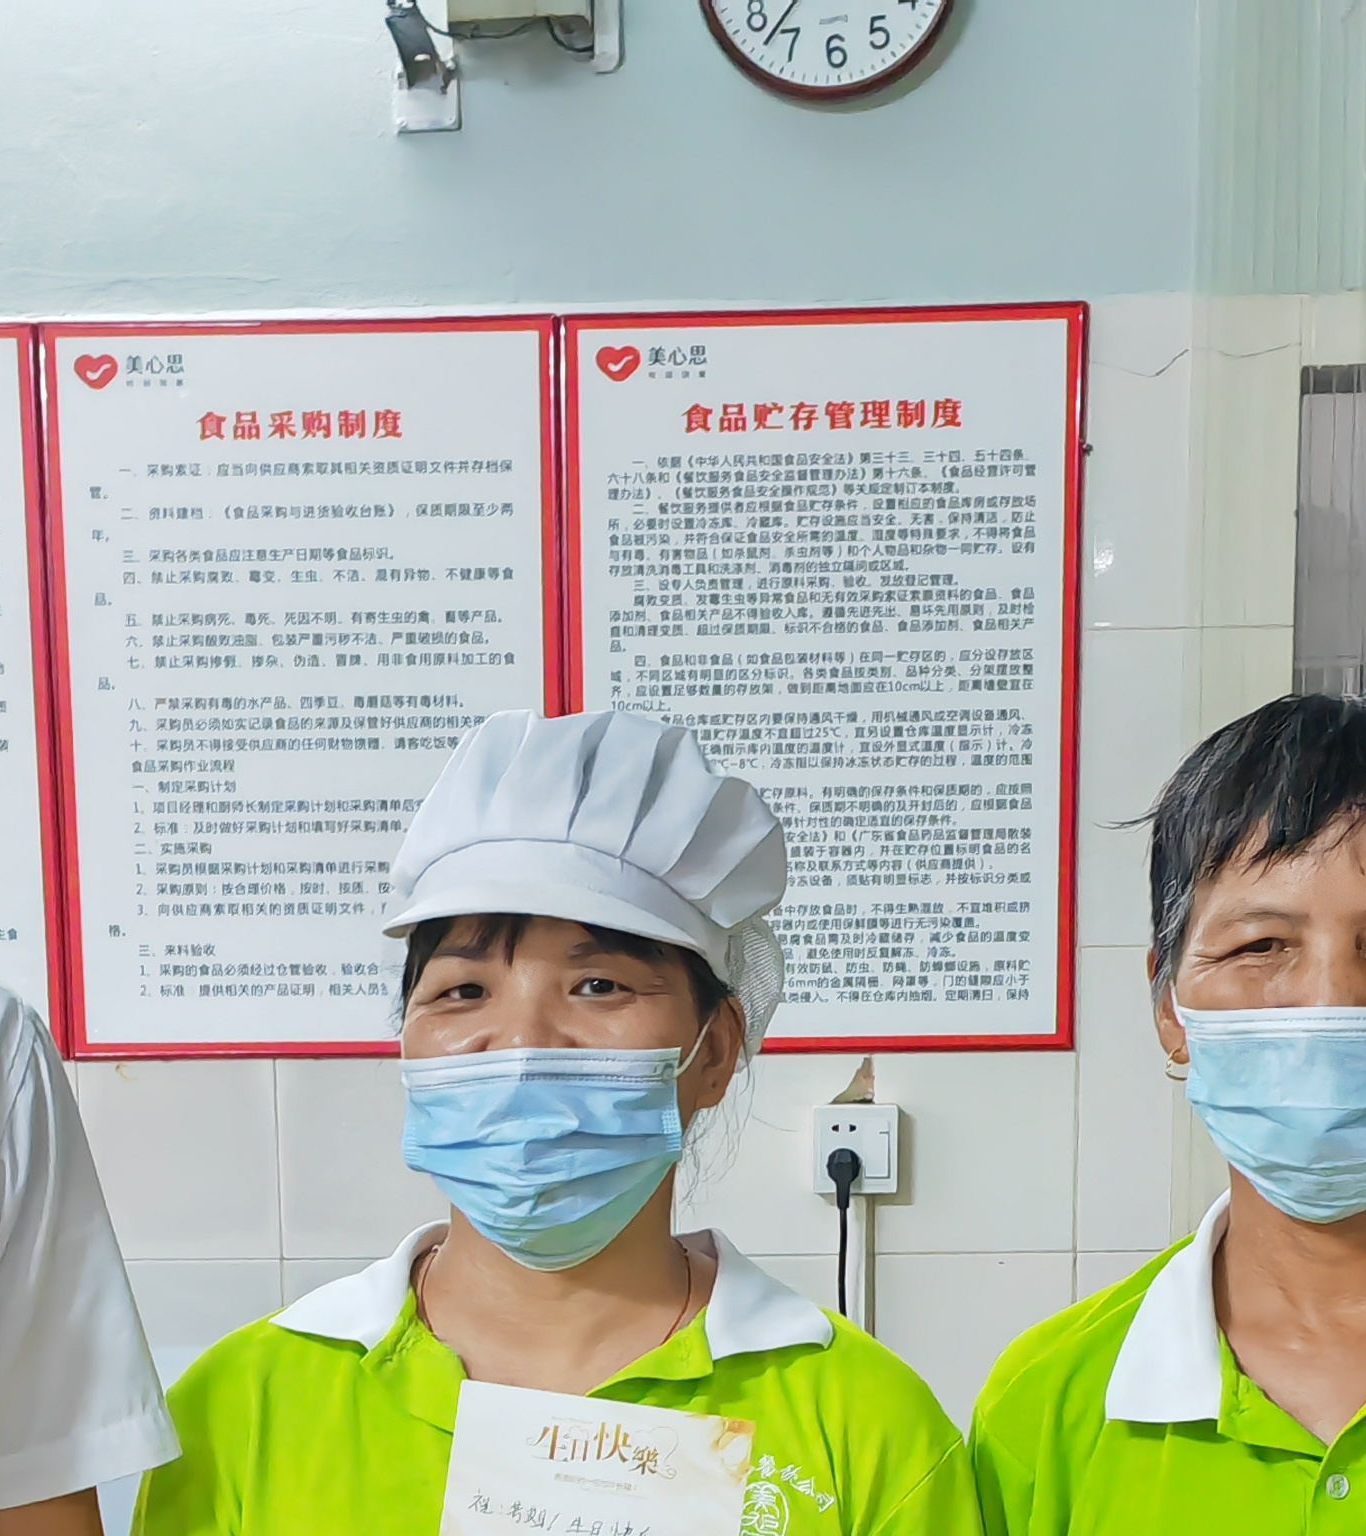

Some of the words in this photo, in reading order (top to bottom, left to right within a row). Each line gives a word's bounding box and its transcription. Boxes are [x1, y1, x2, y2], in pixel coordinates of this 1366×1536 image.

[781, 27, 800, 62] 7
[869, 15, 891, 50] 5
[826, 33, 848, 68] 6
[125, 354, 185, 375] 美心思
[647, 345, 708, 366] 美心思
[196, 408, 404, 441] 食品采购制度
[681, 398, 963, 433] 食品贮存管理制度
